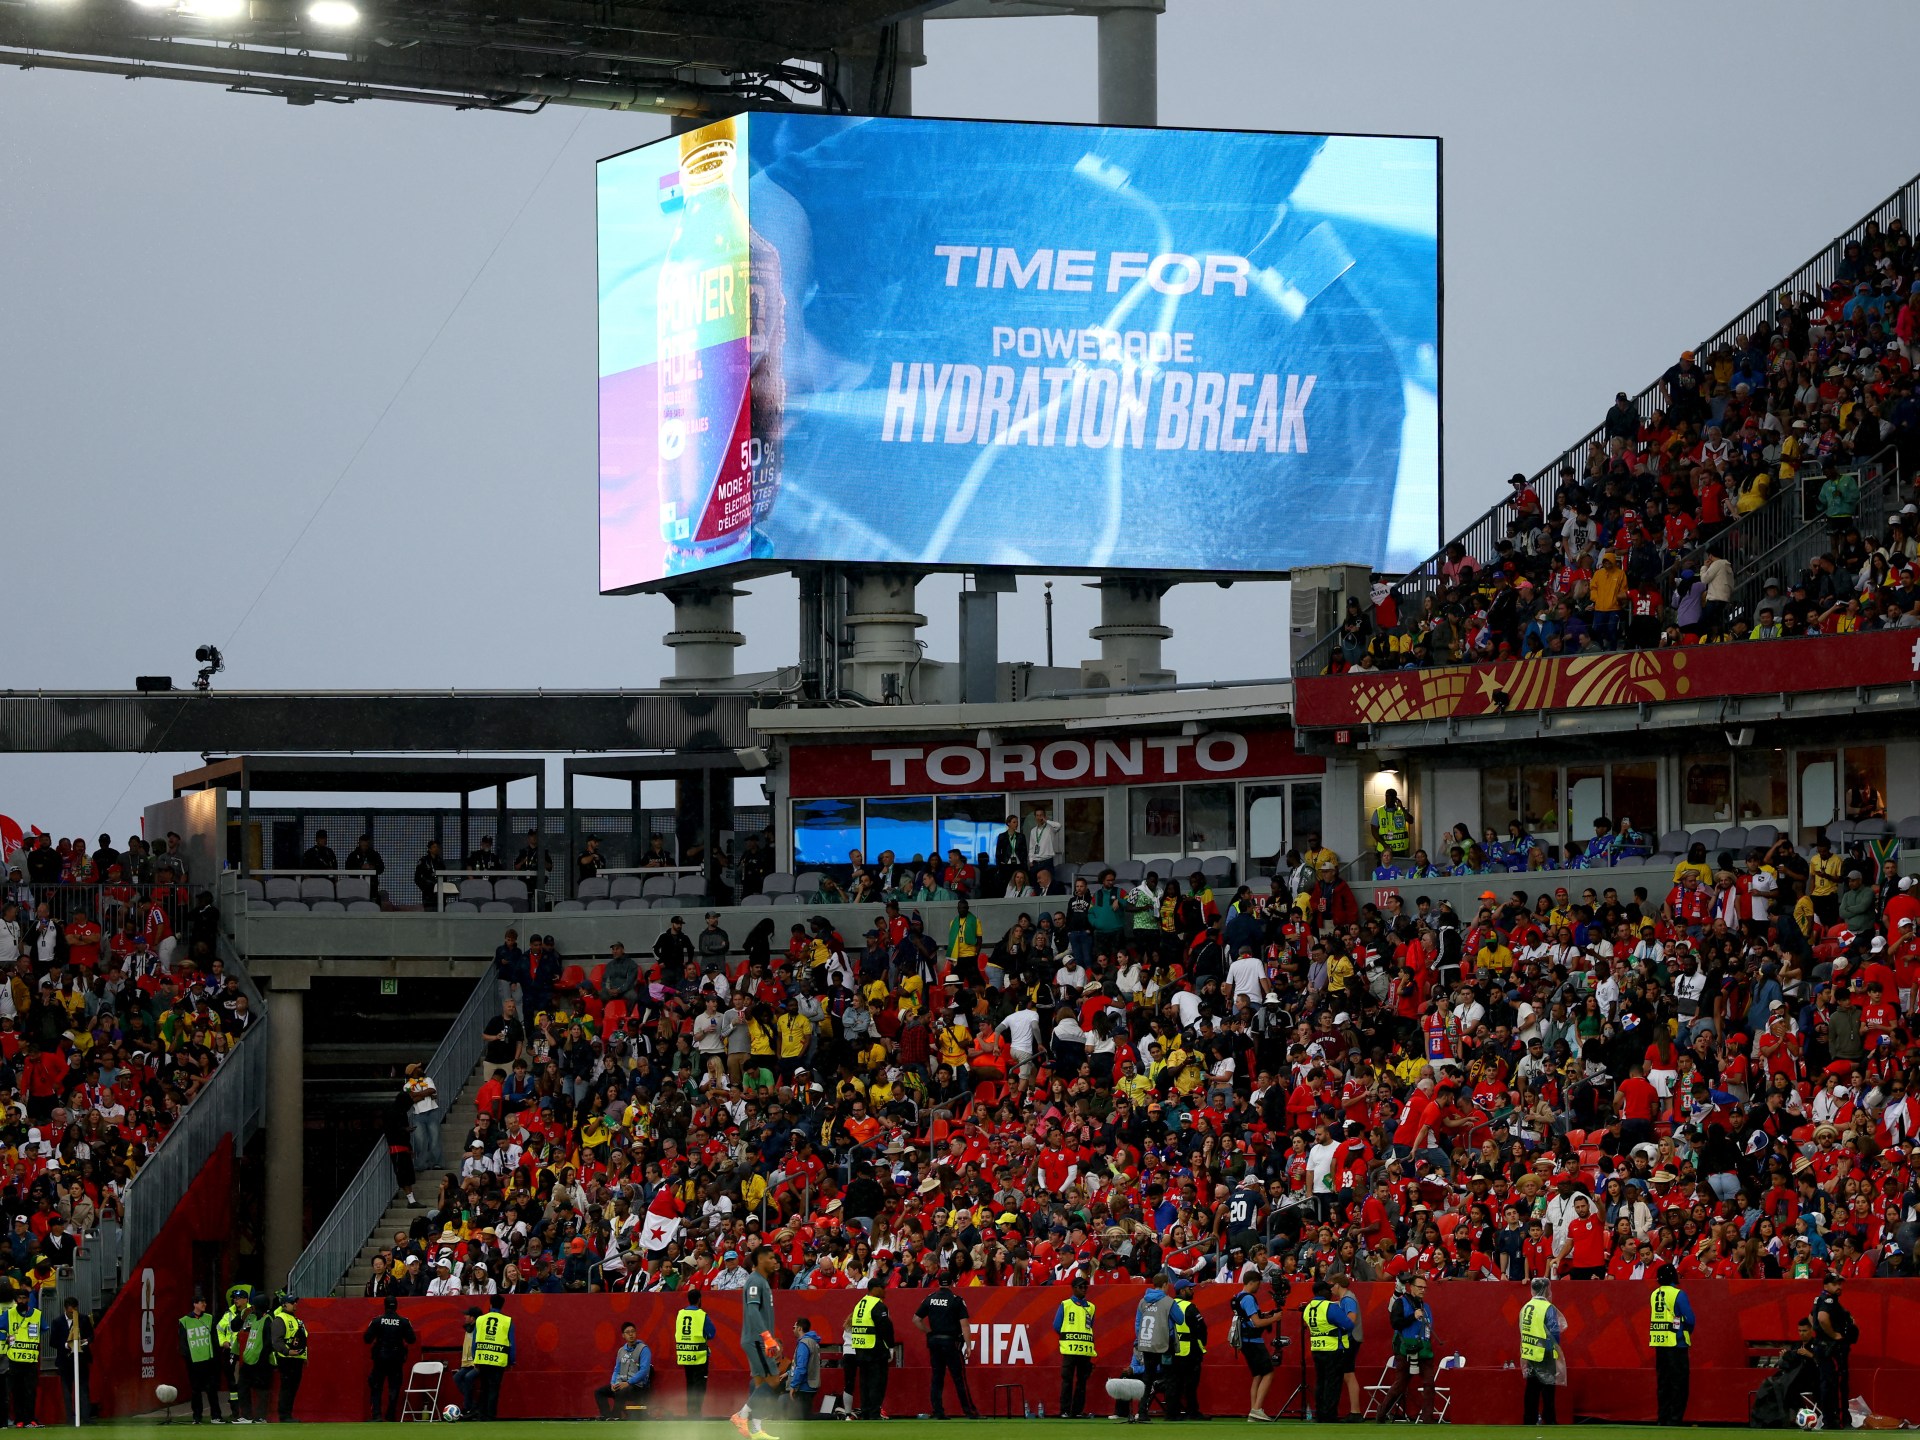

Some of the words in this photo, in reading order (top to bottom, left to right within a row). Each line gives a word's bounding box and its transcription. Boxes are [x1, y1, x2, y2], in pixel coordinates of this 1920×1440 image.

[934, 245, 1096, 292] TIME
[1105, 252, 1250, 297] FOR
[881, 362, 1154, 449] HYDRATION
[1155, 371, 1317, 453] BREAK
[1337, 731, 1348, 743] EXIT
[871, 732, 1248, 786] TORONTO
[1230, 1200, 1247, 1222] 20
[930, 1298, 948, 1307] POLICE
[381, 1317, 400, 1326] POLICE
[187, 1325, 209, 1339] FIF
[476, 1342, 505, 1352] SECURITY
[963, 1323, 1033, 1365] FIFA
[1068, 1344, 1093, 1353] 17511
[12, 1352, 37, 1360] 17634
